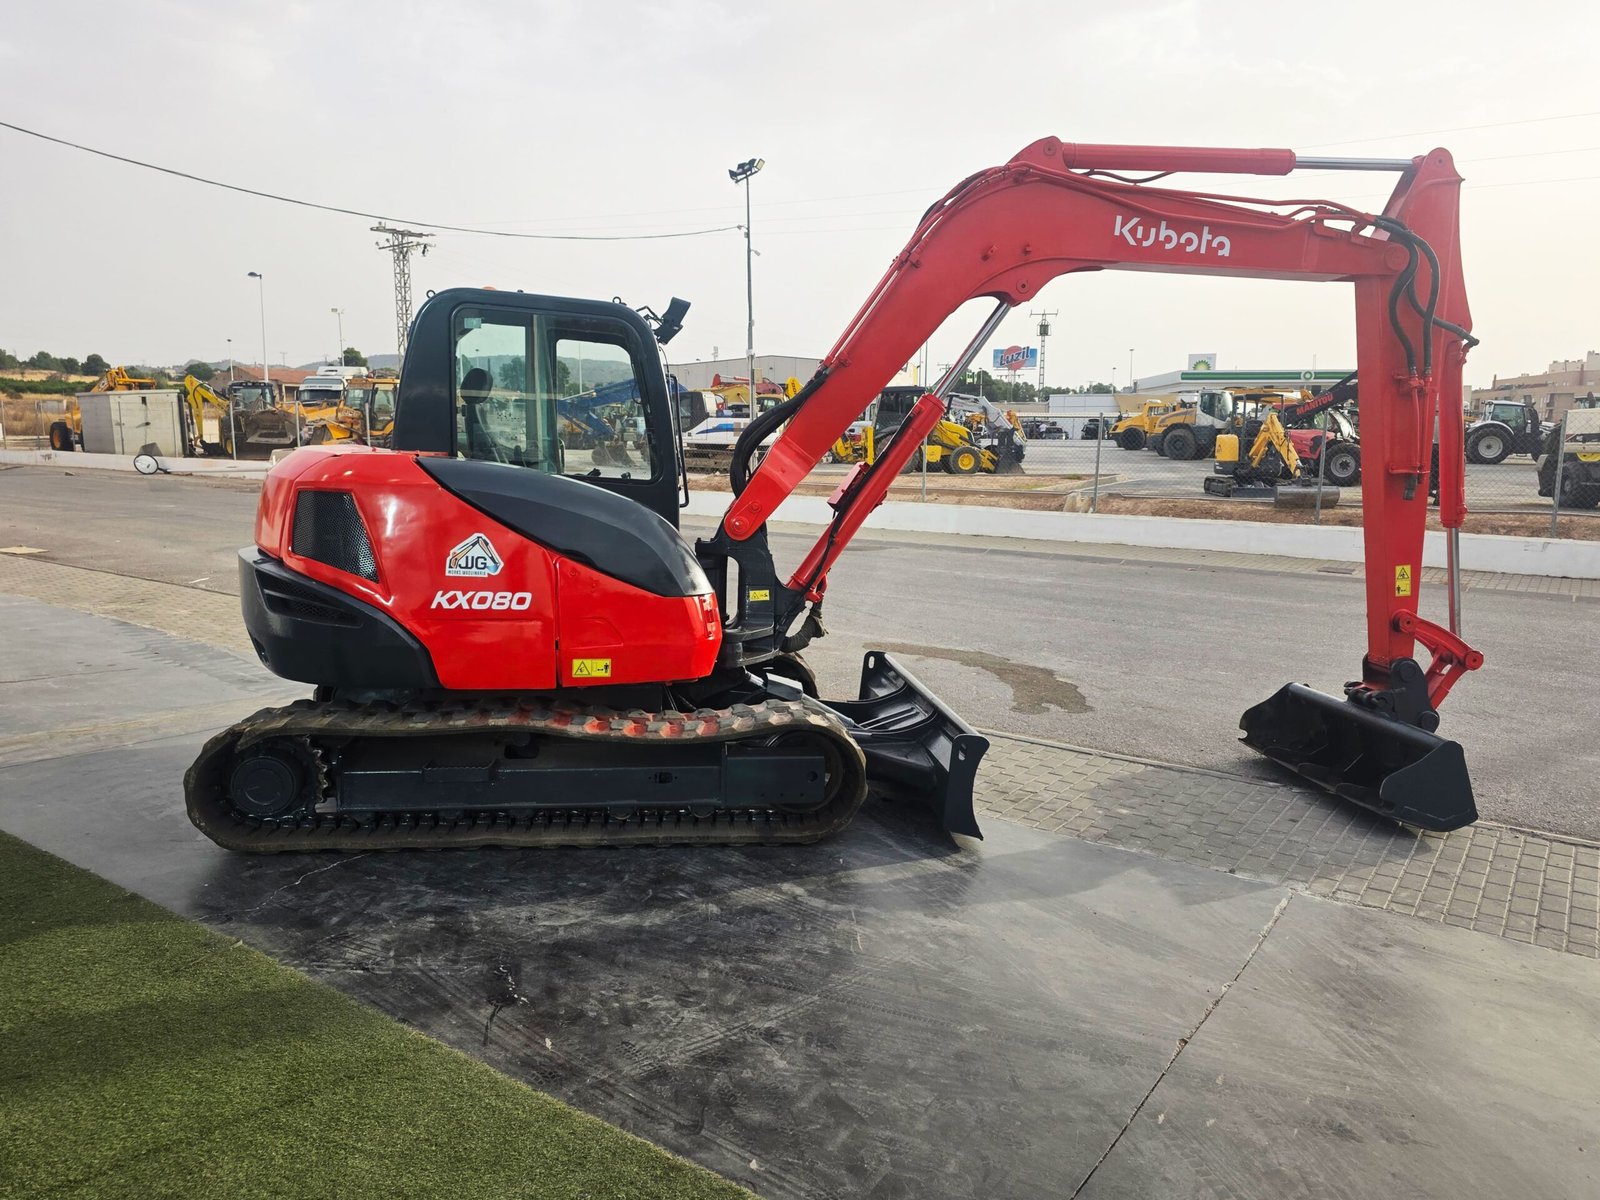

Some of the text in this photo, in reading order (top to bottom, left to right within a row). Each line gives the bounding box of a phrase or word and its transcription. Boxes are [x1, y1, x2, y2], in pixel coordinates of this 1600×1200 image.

[1113, 215, 1231, 257] Kubota
[999, 346, 1030, 366] Luzil
[1296, 391, 1334, 416] MANITOU
[430, 590, 533, 611] KX080
